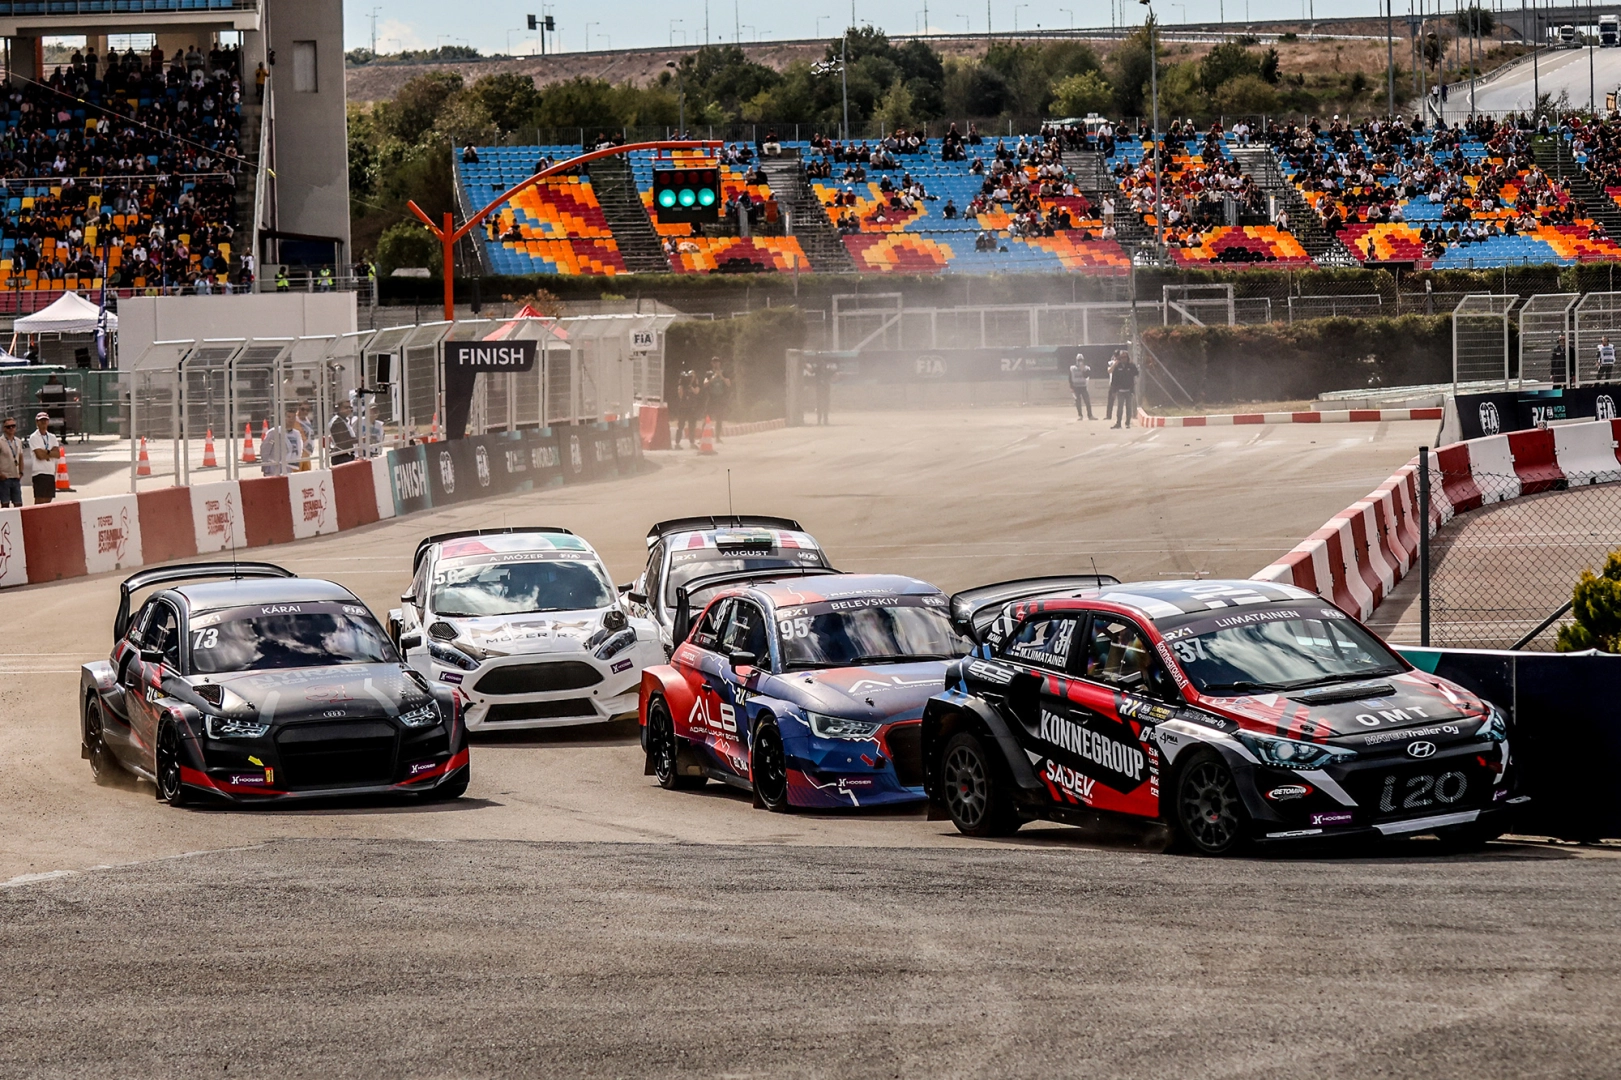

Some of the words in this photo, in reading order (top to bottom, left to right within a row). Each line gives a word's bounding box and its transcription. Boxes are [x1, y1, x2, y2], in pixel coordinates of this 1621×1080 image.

[459, 348, 524, 365] FINISH
[393, 460, 428, 500] FINISH
[503, 553, 544, 561] MÓZER
[261, 605, 302, 614] KÁRAI
[831, 598, 899, 610] BELEVSKIY
[780, 618, 809, 640] 95
[1215, 611, 1300, 627] LIIMATAINEN
[192, 628, 219, 650] 73
[1173, 637, 1207, 663] 37
[1156, 640, 1189, 690] konnegroup.fi
[848, 676, 945, 693] AL
[688, 695, 737, 733] ALB
[1119, 698, 1142, 717] RX
[1355, 706, 1430, 727] OMT
[1442, 725, 1460, 735] Oy
[1040, 709, 1144, 781] KONNEGROUP
